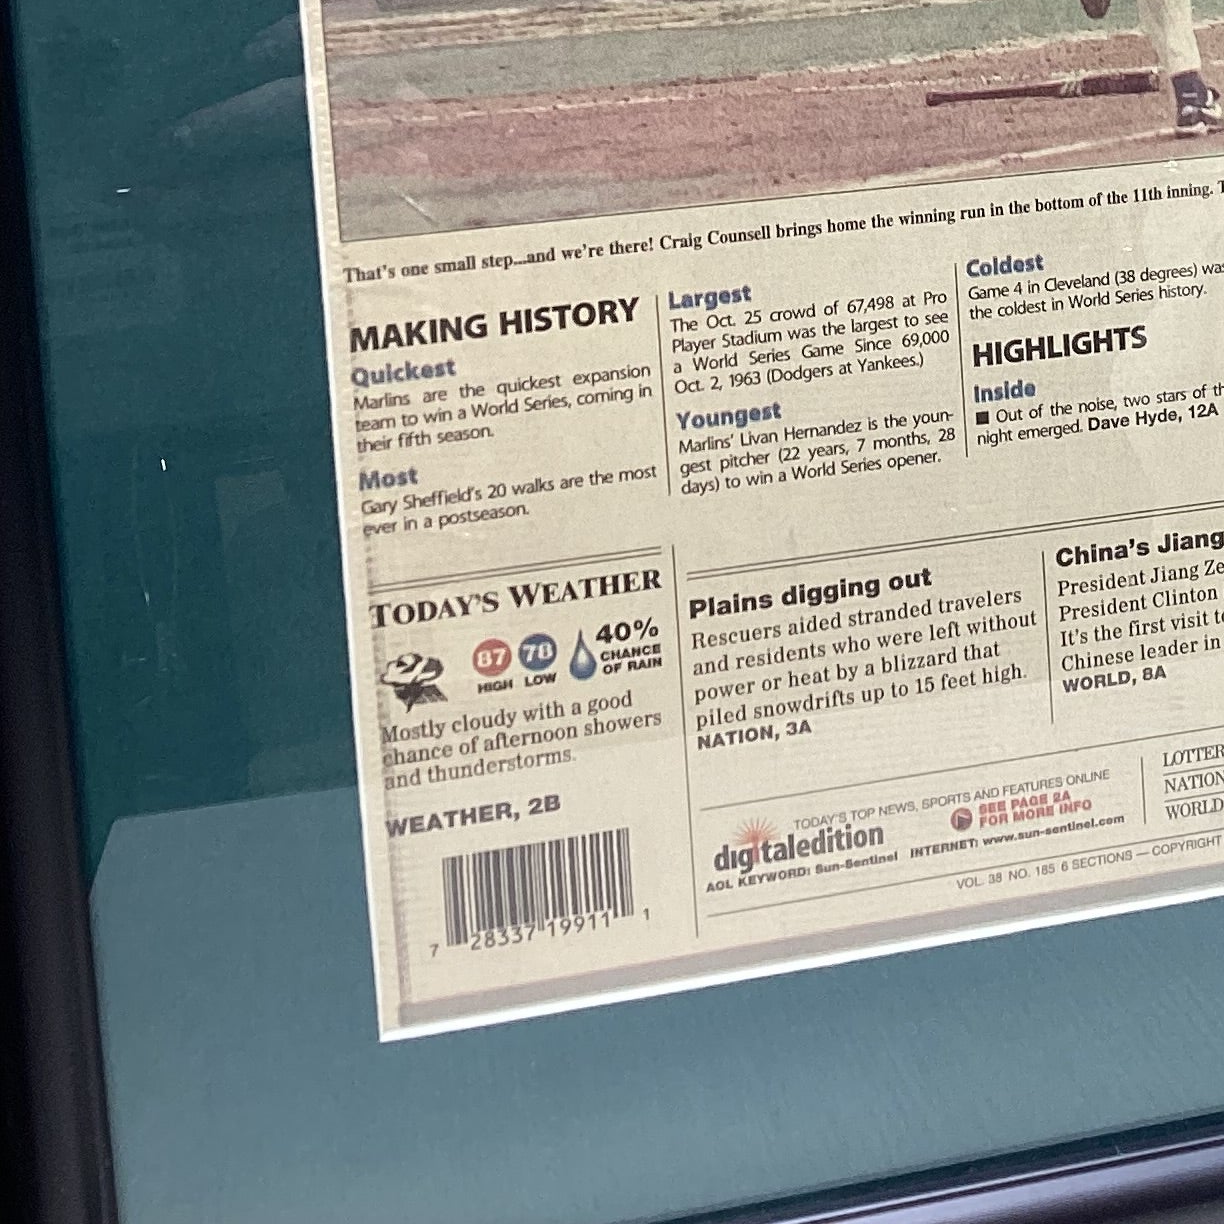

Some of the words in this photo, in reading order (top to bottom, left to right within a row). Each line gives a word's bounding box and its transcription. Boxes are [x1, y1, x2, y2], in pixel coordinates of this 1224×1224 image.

[966, 254, 1044, 278] Coldest
[968, 285, 1009, 300] Game
[1013, 281, 1023, 295] 4
[1028, 280, 1040, 294] in
[1044, 271, 1110, 292] Cleveland
[1115, 270, 1136, 287] (38
[1140, 262, 1197, 284] degrees)
[668, 284, 752, 311] Largest
[350, 314, 488, 353] MAKING
[499, 296, 640, 336] HISTORY
[973, 325, 1147, 367] HIGHLIGHTS
[350, 358, 457, 389] Quickest
[974, 378, 1036, 404] Inside
[675, 401, 782, 431] Youngest
[359, 466, 419, 492] Most
[1056, 538, 1150, 567] China's
[1157, 531, 1224, 554] Jiang
[507, 569, 662, 608] WEATHER
[689, 593, 773, 620] Plains
[781, 578, 880, 607] digging
[889, 567, 932, 591] out
[1058, 570, 1146, 597] President
[1150, 564, 1199, 584] Jiang
[596, 616, 659, 644] 40%
[691, 625, 781, 650] Rescuers
[788, 611, 842, 636] aided
[848, 599, 932, 627] stranded
[938, 590, 1022, 614] travelers
[477, 648, 507, 669] 87
[600, 643, 661, 662] CHANCE
[602, 660, 622, 675] OF
[627, 657, 662, 672] RAIN
[477, 679, 513, 694] HIGH
[524, 672, 557, 687] LOW
[1062, 670, 1137, 693] WORLD,
[379, 719, 446, 745] Mostly
[451, 708, 517, 733] cloudy
[523, 700, 565, 722] with
[571, 702, 582, 716] a
[588, 689, 632, 716] good
[697, 724, 780, 751] NATION,
[786, 719, 812, 736] 3A
[385, 801, 520, 839] WEATHER,
[528, 794, 561, 816] 2B
[1165, 797, 1224, 820] WORLD
[713, 823, 885, 874] digitaledition
[430, 944, 439, 957] 7
[471, 924, 536, 951] 28337
[547, 912, 610, 937] 19911
[643, 908, 649, 920] 1
